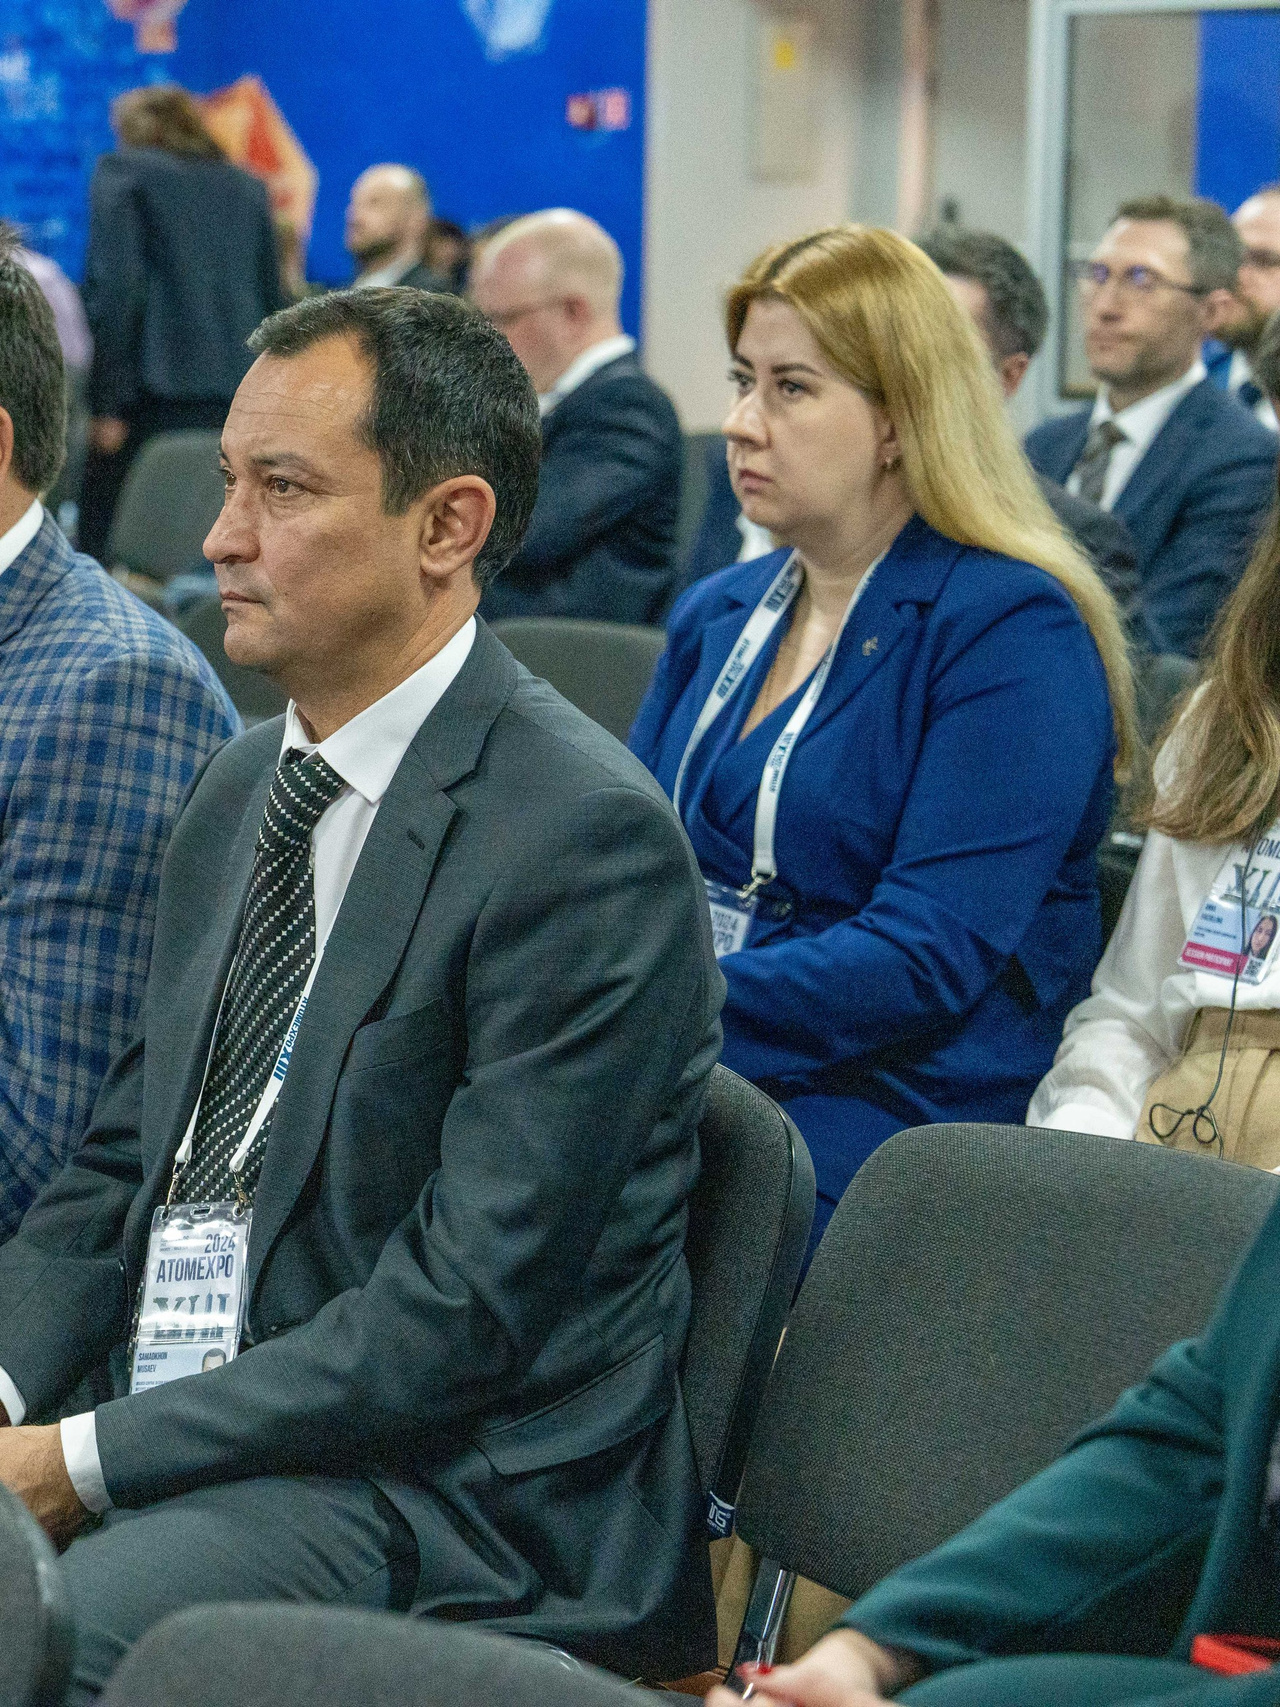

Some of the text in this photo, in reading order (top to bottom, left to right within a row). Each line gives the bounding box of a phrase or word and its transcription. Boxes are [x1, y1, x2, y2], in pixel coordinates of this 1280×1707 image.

[273, 1046, 292, 1081] XIII
[204, 1232, 237, 1253] 2024
[156, 1254, 235, 1283] ATOMEXPO
